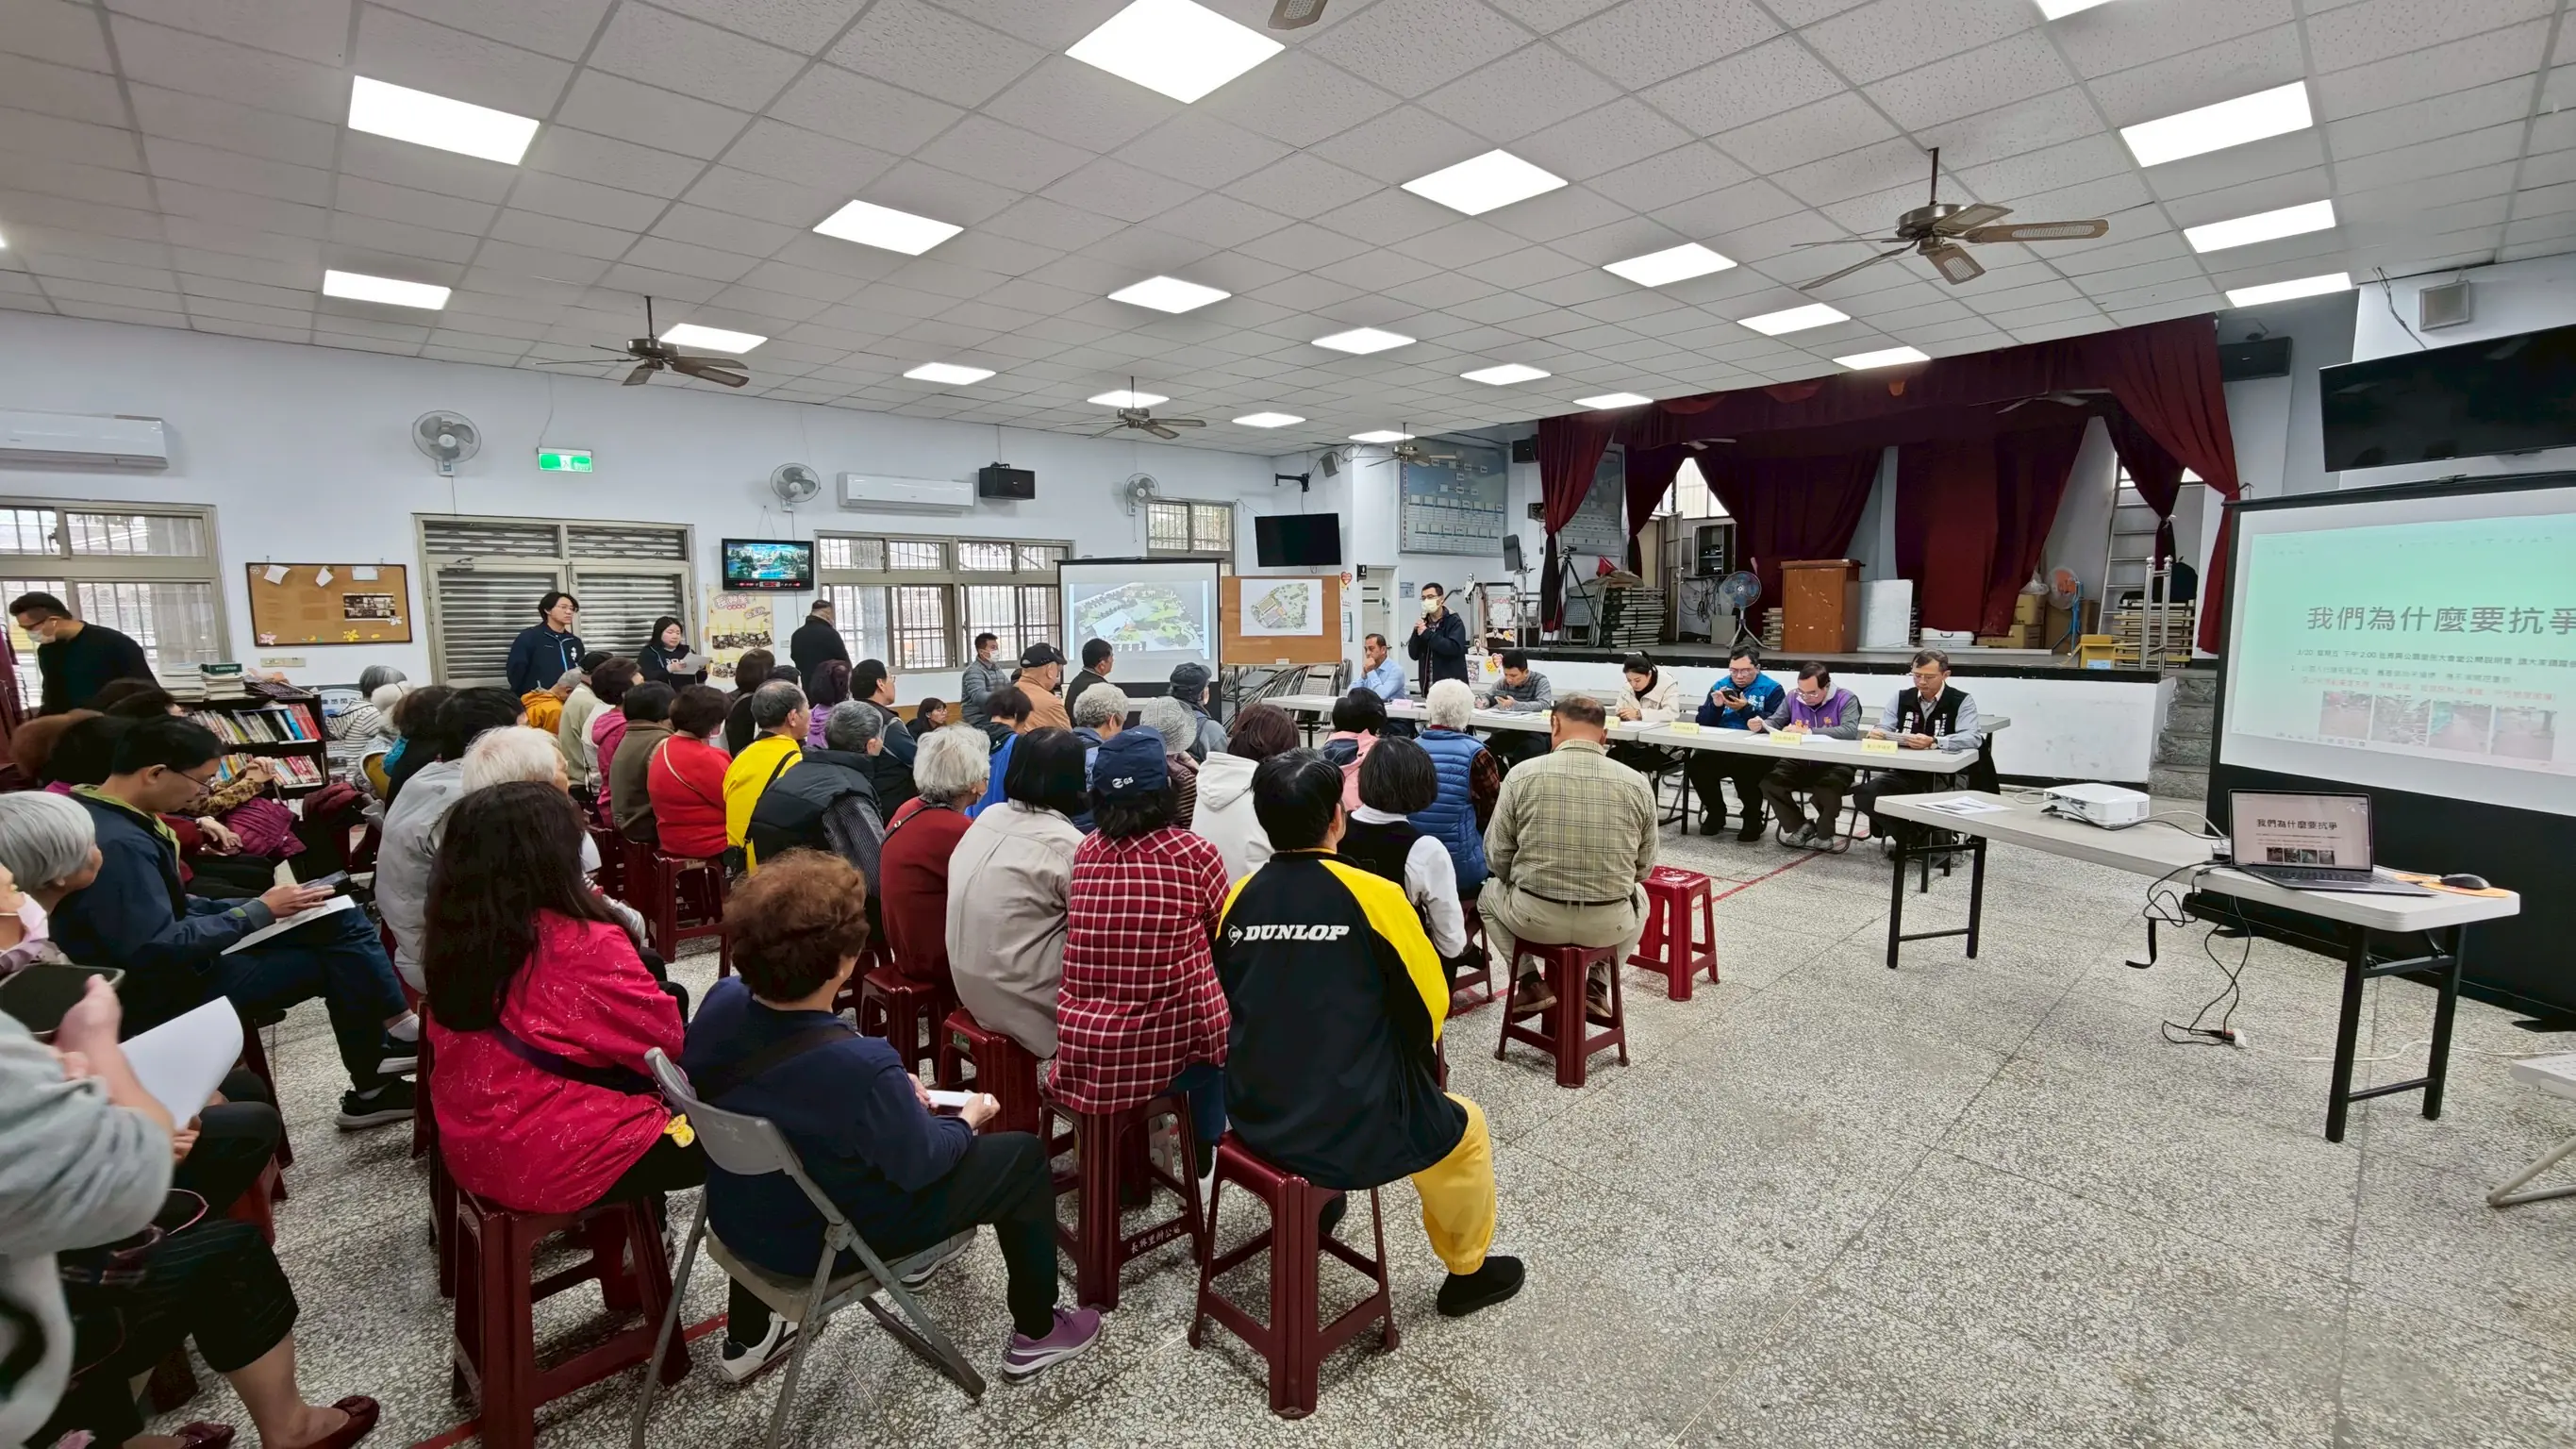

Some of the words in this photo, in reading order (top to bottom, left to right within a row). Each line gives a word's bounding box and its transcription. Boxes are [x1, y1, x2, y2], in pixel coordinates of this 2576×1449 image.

[2307, 606, 2576, 635] 我們為什麼要抗爭
[2256, 819, 2338, 830] 我們為什麼要抗爭
[1243, 924, 1350, 941] DUNLOP
